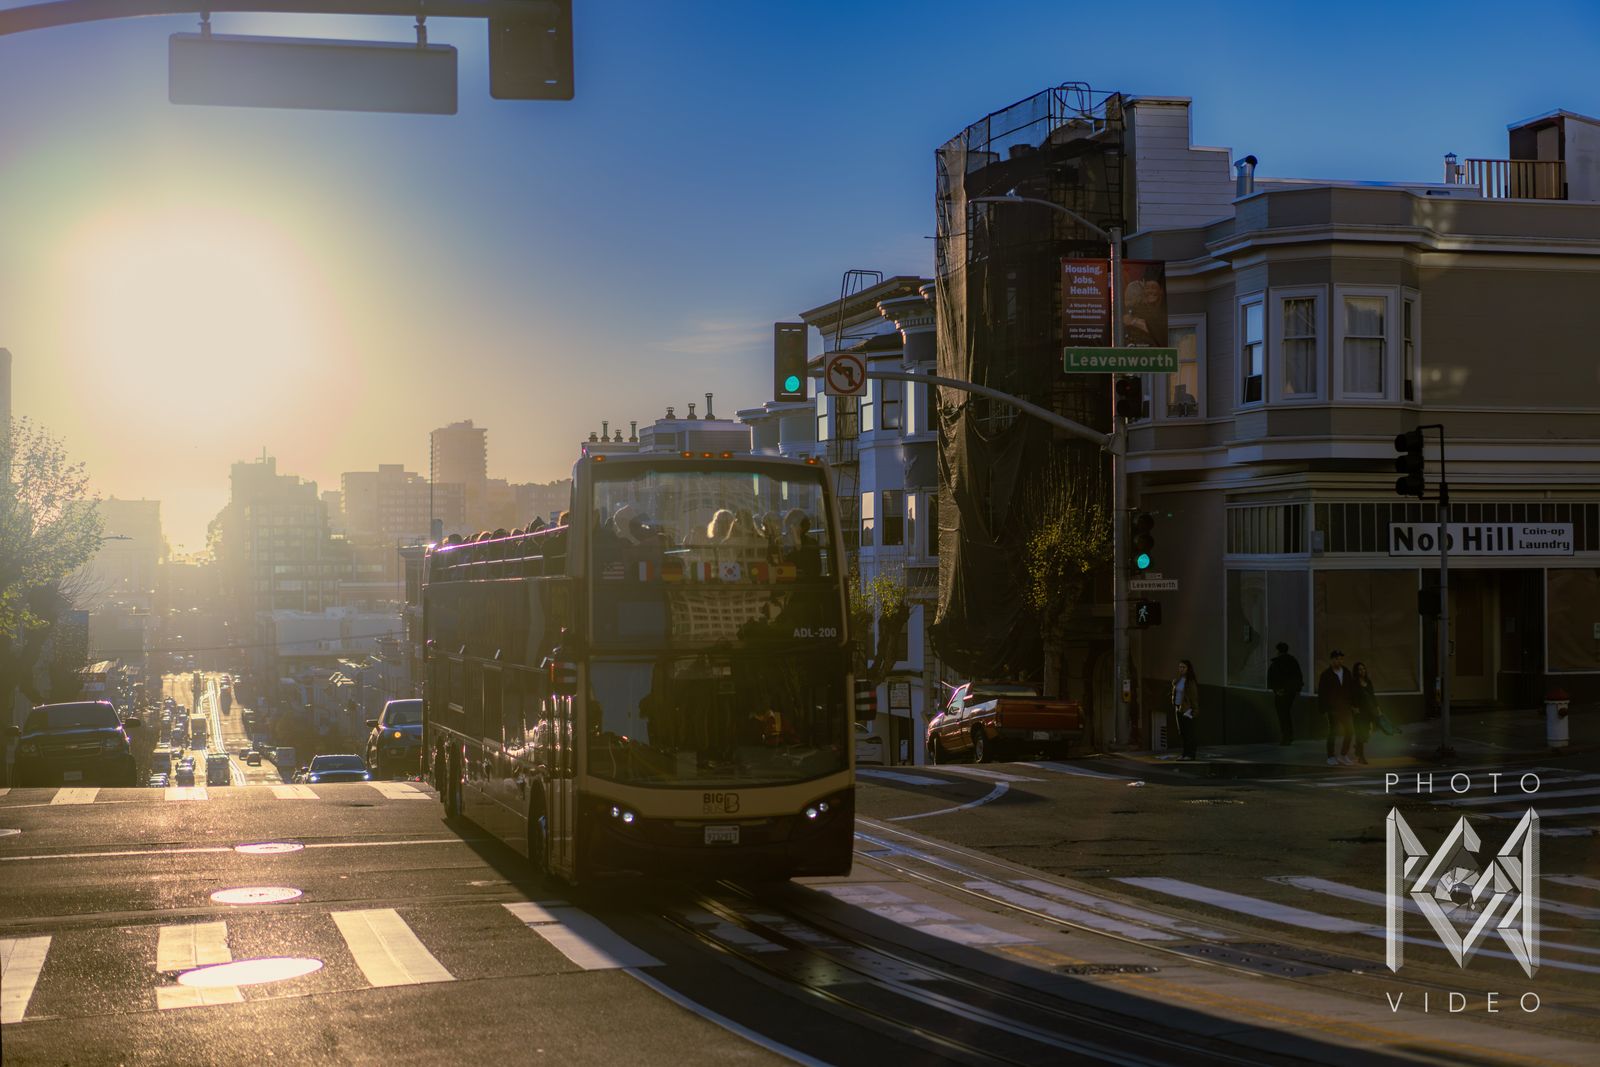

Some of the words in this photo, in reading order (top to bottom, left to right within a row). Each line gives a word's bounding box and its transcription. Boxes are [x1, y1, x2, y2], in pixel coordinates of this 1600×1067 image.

[1065, 264, 1103, 275] Housing.
[1072, 276, 1096, 284] Jobs.
[1070, 286, 1101, 295] Health.
[1070, 353, 1173, 367] Leavenworth
[1522, 527, 1565, 537] Coin-op
[1394, 526, 1454, 551] Nob
[1462, 526, 1514, 551] Hill
[1519, 540, 1570, 551] Laundry
[793, 628, 837, 638] ADL-200
[703, 793, 723, 804] BIG
